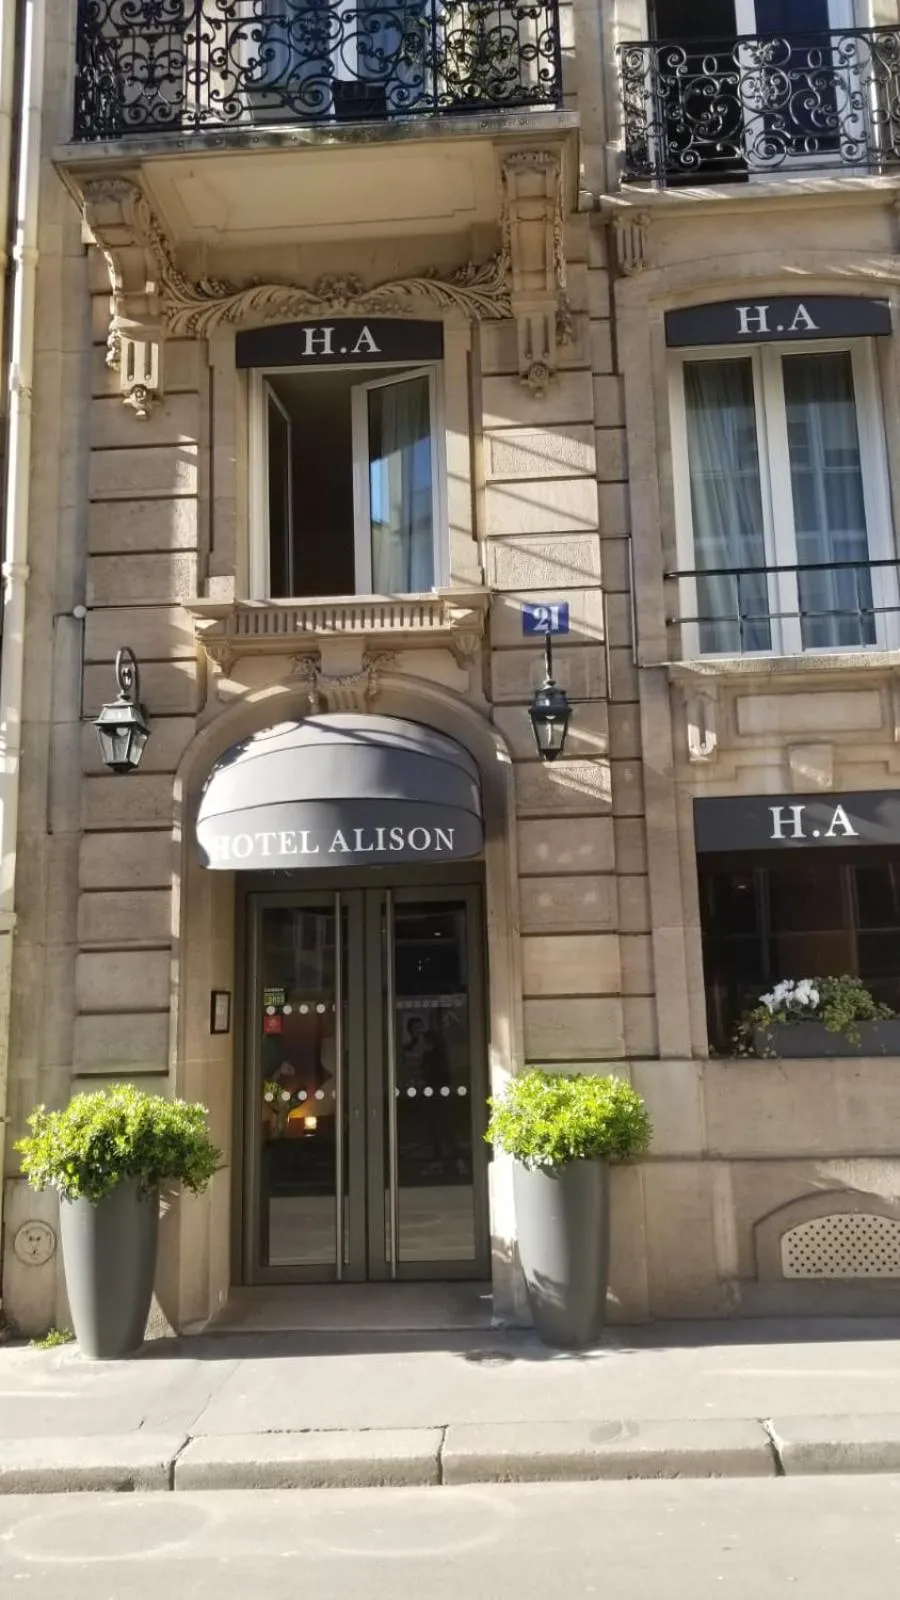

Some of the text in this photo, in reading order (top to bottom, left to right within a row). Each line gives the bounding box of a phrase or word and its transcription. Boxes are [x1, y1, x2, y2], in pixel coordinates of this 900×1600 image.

[735, 303, 820, 334] H.A
[301, 325, 382, 355] H.A
[532, 606, 559, 630] 21
[768, 804, 859, 839] H.A
[213, 827, 455, 860] HOTEL ALISON
